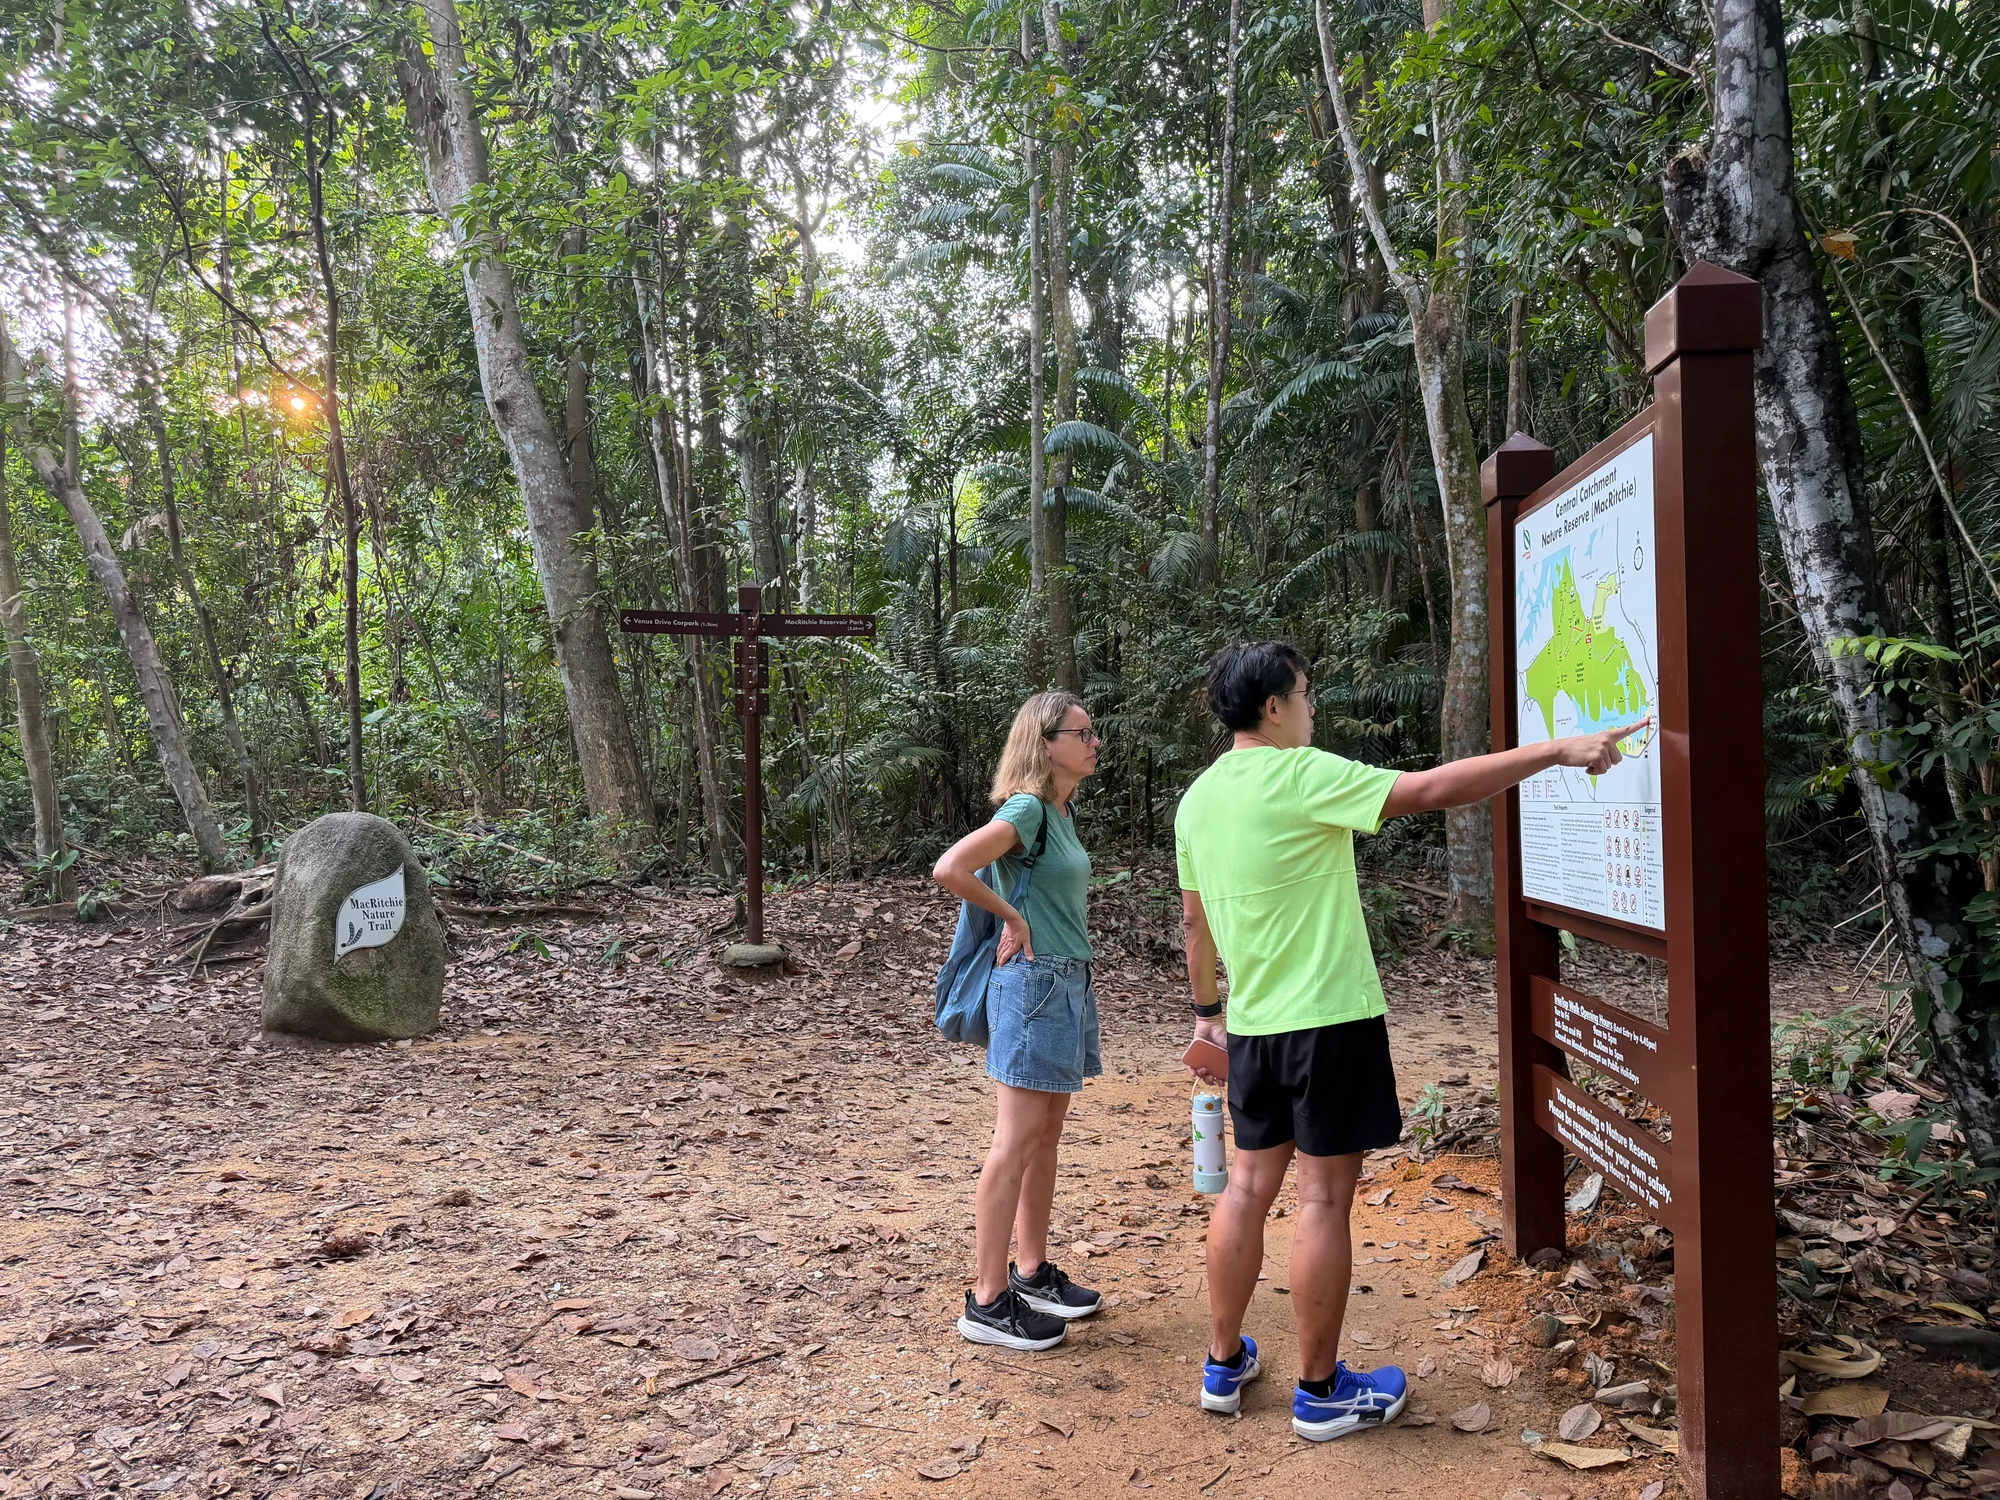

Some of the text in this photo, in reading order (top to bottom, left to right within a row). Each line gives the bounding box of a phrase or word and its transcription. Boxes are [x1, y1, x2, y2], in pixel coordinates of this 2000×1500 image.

[1541, 477, 1636, 548] Nature Reserve (MacRitchie)
[1556, 467, 1617, 518] Central Catchment
[633, 617, 653, 625] Venus
[673, 619, 699, 627] Carpark
[351, 897, 404, 909] MacRitchie
[362, 910, 395, 920] Nature
[368, 920, 392, 931] Trail
[1568, 999, 1580, 1015] Walk
[1580, 1005, 1599, 1026] Opening
[1599, 1014, 1613, 1032] Hours
[1622, 1026, 1633, 1041] Entry
[1592, 1024, 1603, 1038] 9am
[1607, 1032, 1617, 1045] 5pm
[1571, 1038, 1588, 1057] Mondays
[1588, 1050, 1601, 1064] except
[1607, 1058, 1620, 1073] Public
[1620, 1065, 1640, 1085] Holidays
[1614, 1048, 1624, 1062] 5pm
[1556, 1087, 1658, 1170] You are entering a Nature Reserve.
[1548, 1099, 1672, 1204] Please be responsible for your own safety.
[1557, 1122, 1572, 1142] Nature
[1572, 1132, 1589, 1155] Reserve
[1589, 1146, 1609, 1173] Opening
[1626, 1174, 1638, 1193] 7am
[1638, 1185, 1645, 1198] to
[1645, 1189, 1659, 1210] 7pm
